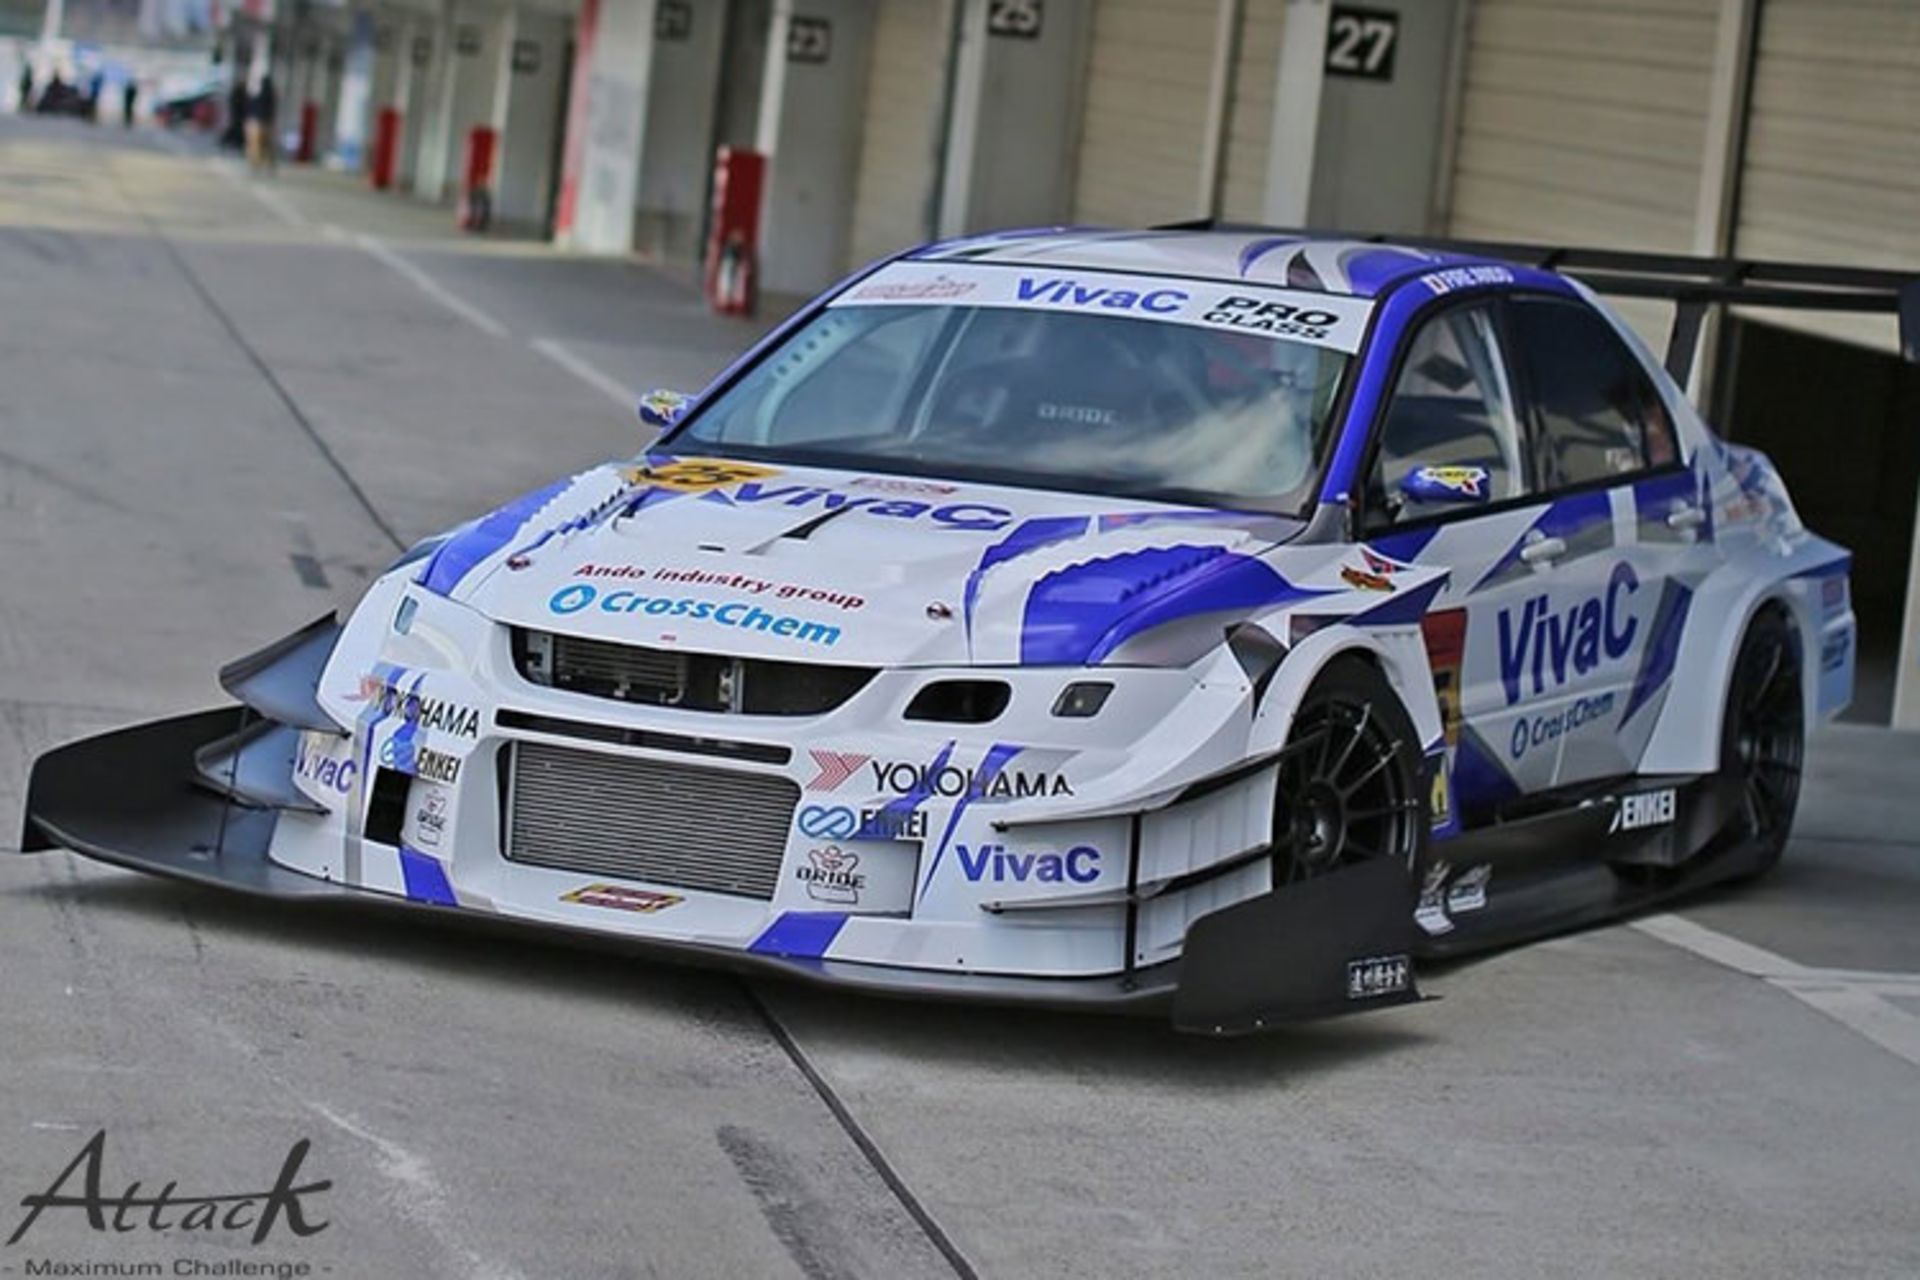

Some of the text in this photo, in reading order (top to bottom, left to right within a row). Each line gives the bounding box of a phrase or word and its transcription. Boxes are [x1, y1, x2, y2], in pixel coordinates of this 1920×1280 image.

[1330, 16, 1393, 71] 27
[1017, 278, 1189, 313] VivaC
[1215, 296, 1339, 327] PRO
[1202, 311, 1330, 340] CLASS
[735, 483, 1012, 531] VivaC
[574, 564, 866, 610] Ando industry group
[600, 591, 842, 647] CrossChem
[1498, 560, 1639, 706] VivaC
[872, 760, 1075, 797] YOKOHAMA
[956, 844, 1101, 883] VivaC
